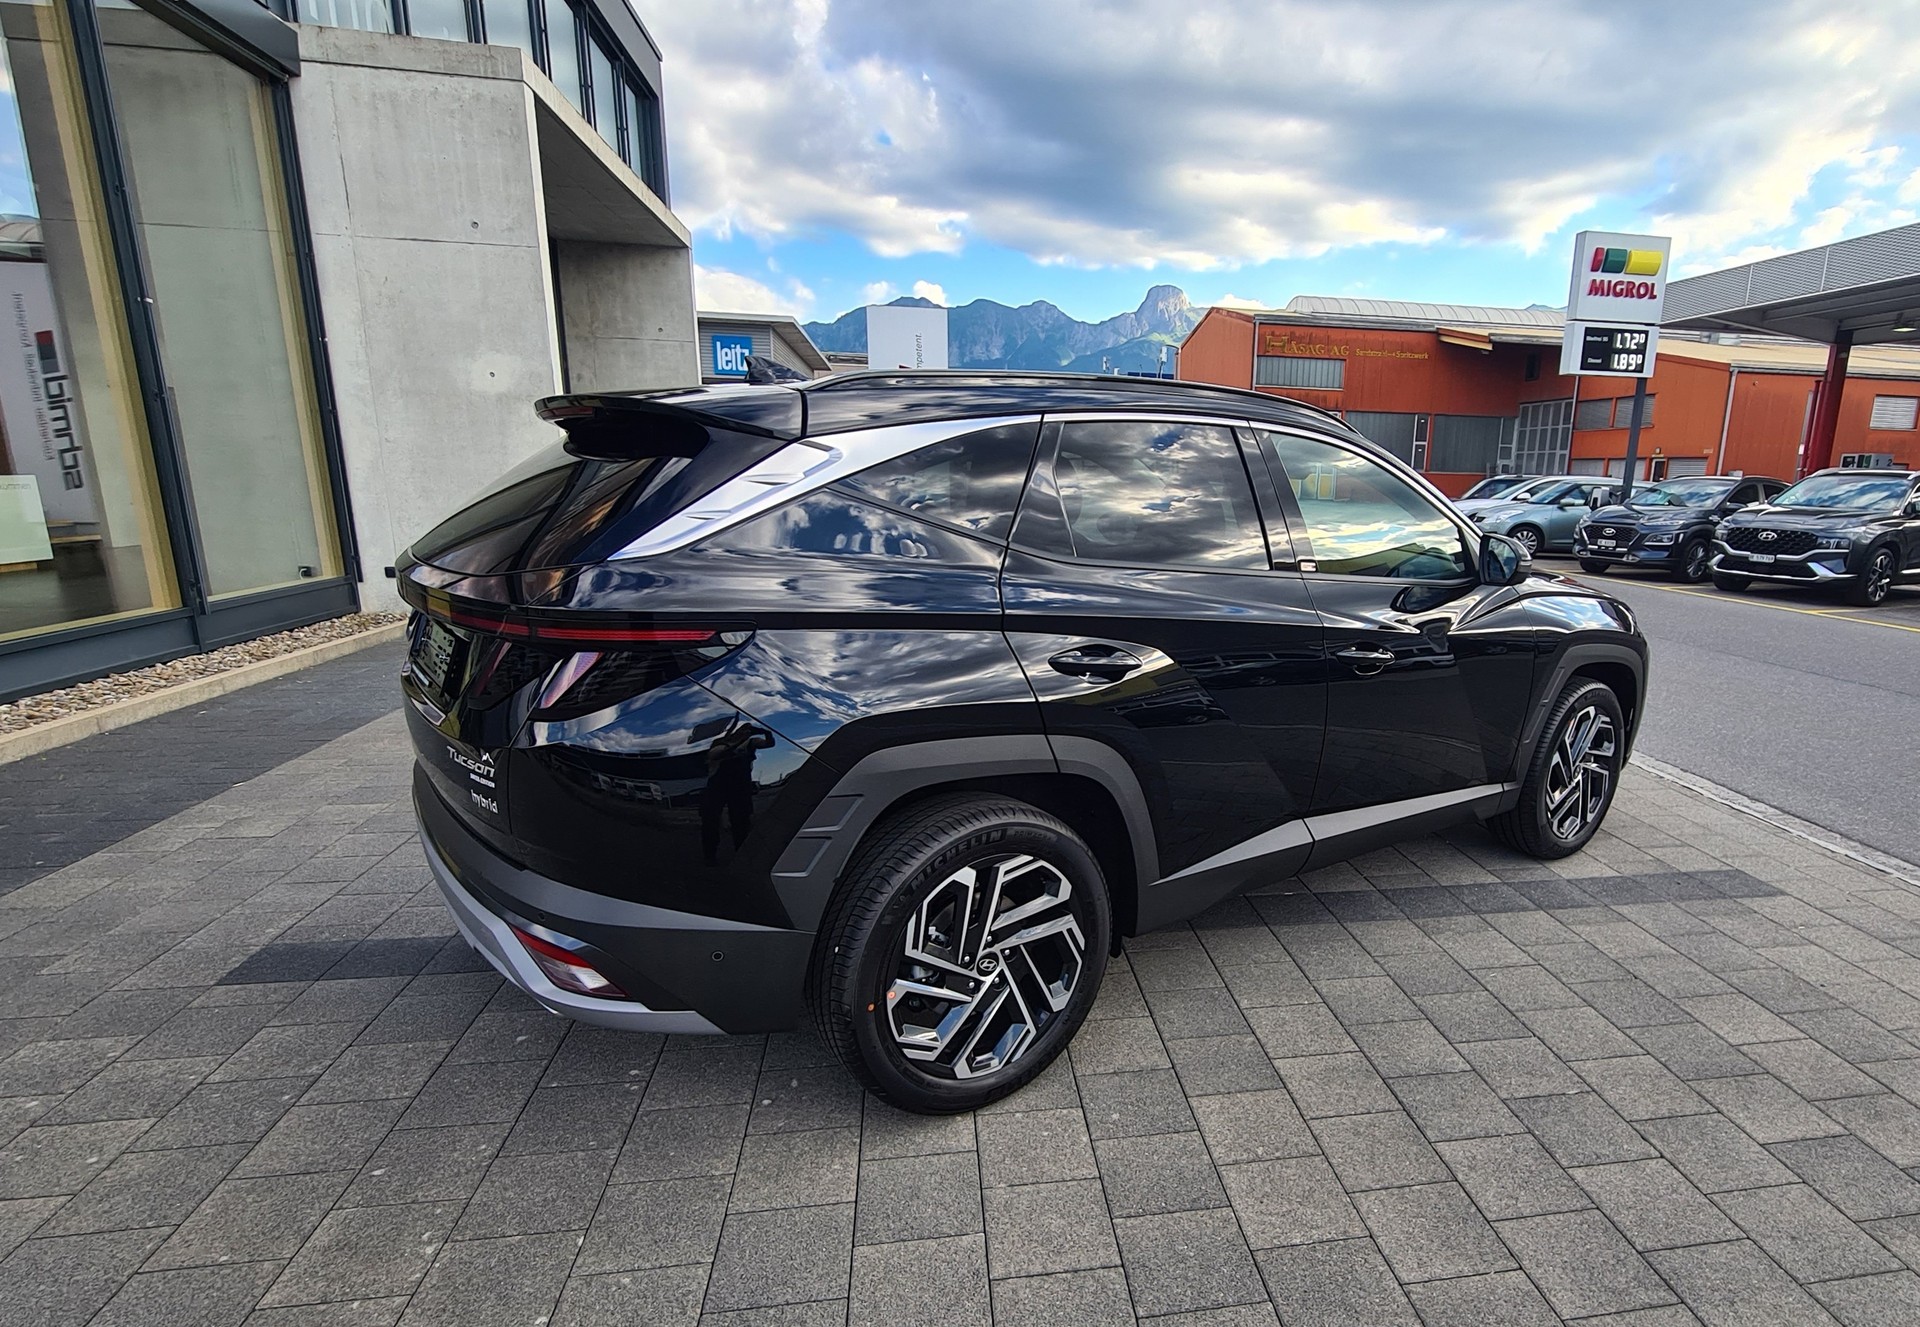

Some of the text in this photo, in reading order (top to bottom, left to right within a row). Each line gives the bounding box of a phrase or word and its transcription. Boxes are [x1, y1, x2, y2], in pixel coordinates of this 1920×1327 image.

[1587, 278, 1657, 300] MIGROL
[715, 341, 750, 371] leitz
[1330, 344, 1349, 356] AG
[470, 788, 499, 814] hybrid
[910, 828, 1005, 890] MICHELIN
